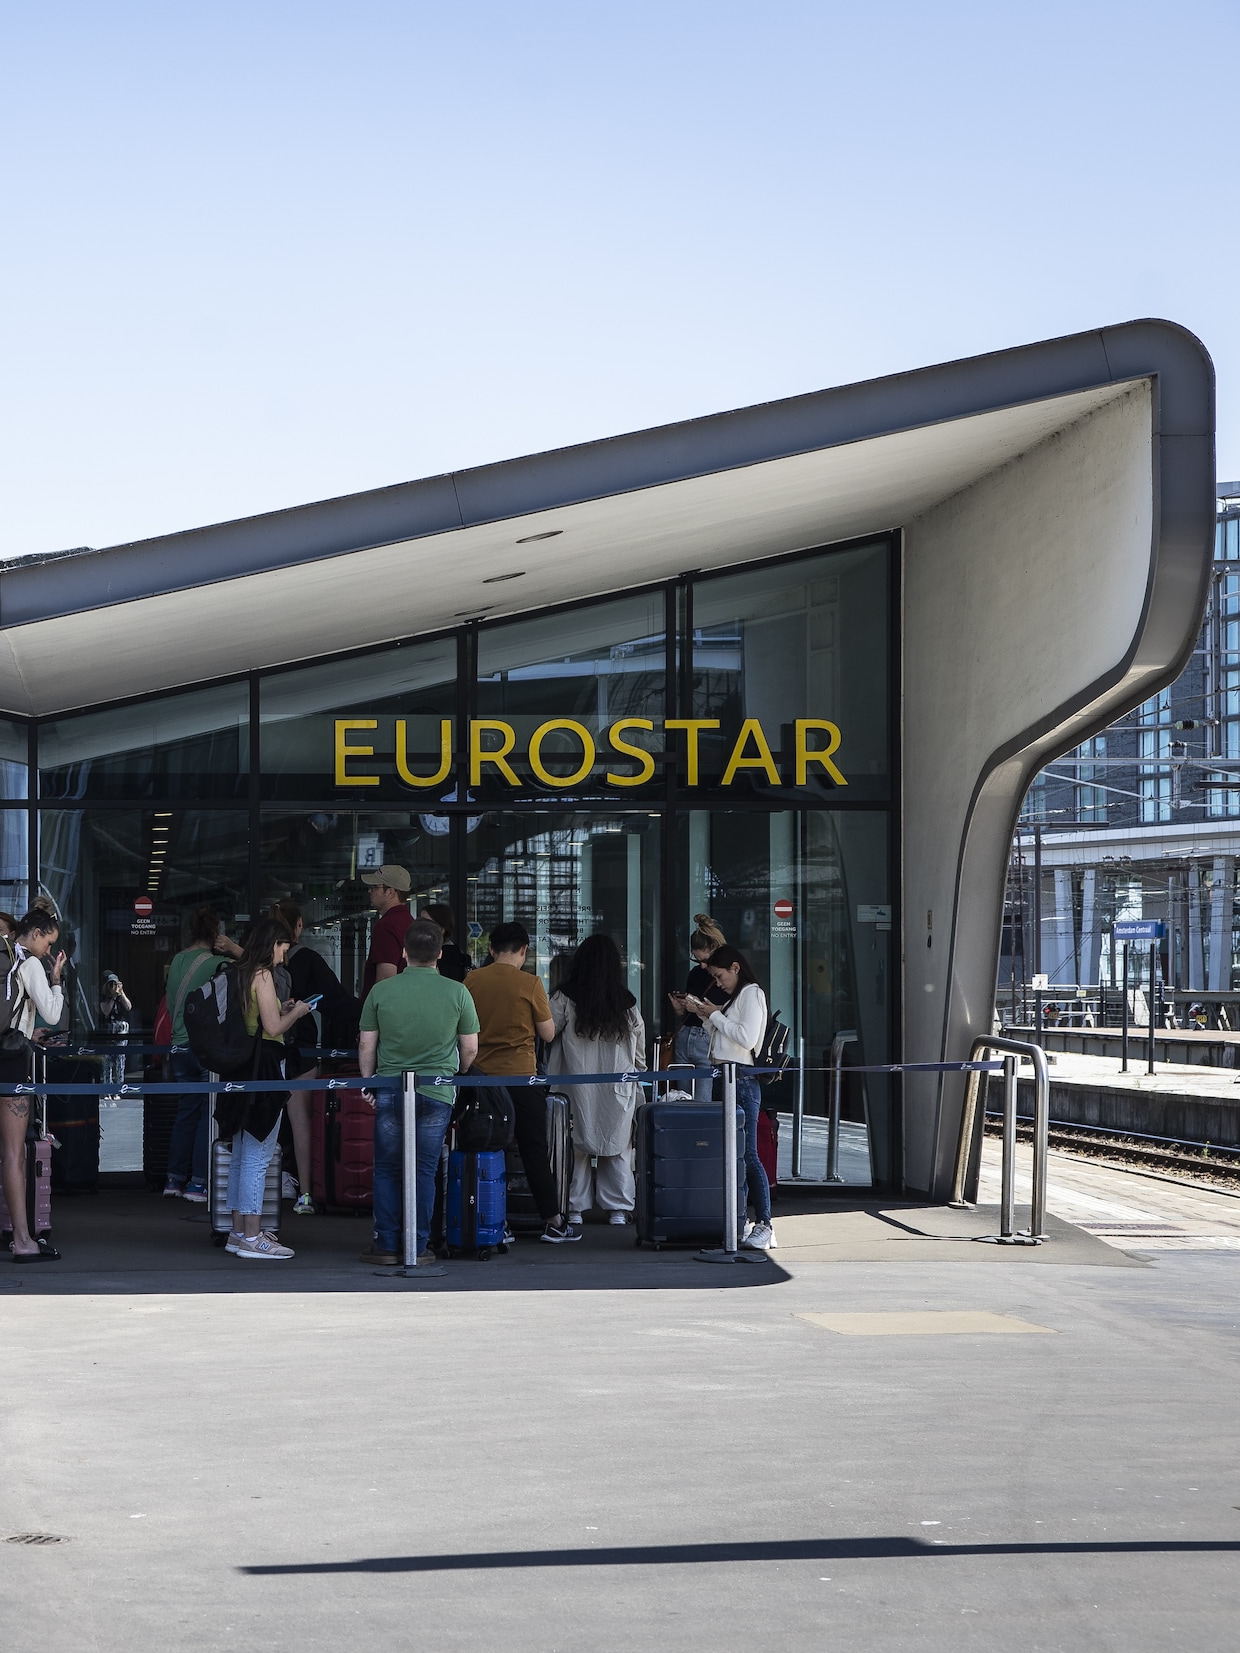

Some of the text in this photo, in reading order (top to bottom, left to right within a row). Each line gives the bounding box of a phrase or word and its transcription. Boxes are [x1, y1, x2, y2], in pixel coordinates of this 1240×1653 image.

[334, 718, 849, 788] EUROSTAR
[1116, 925, 1152, 935] Amsterdam Centraal
